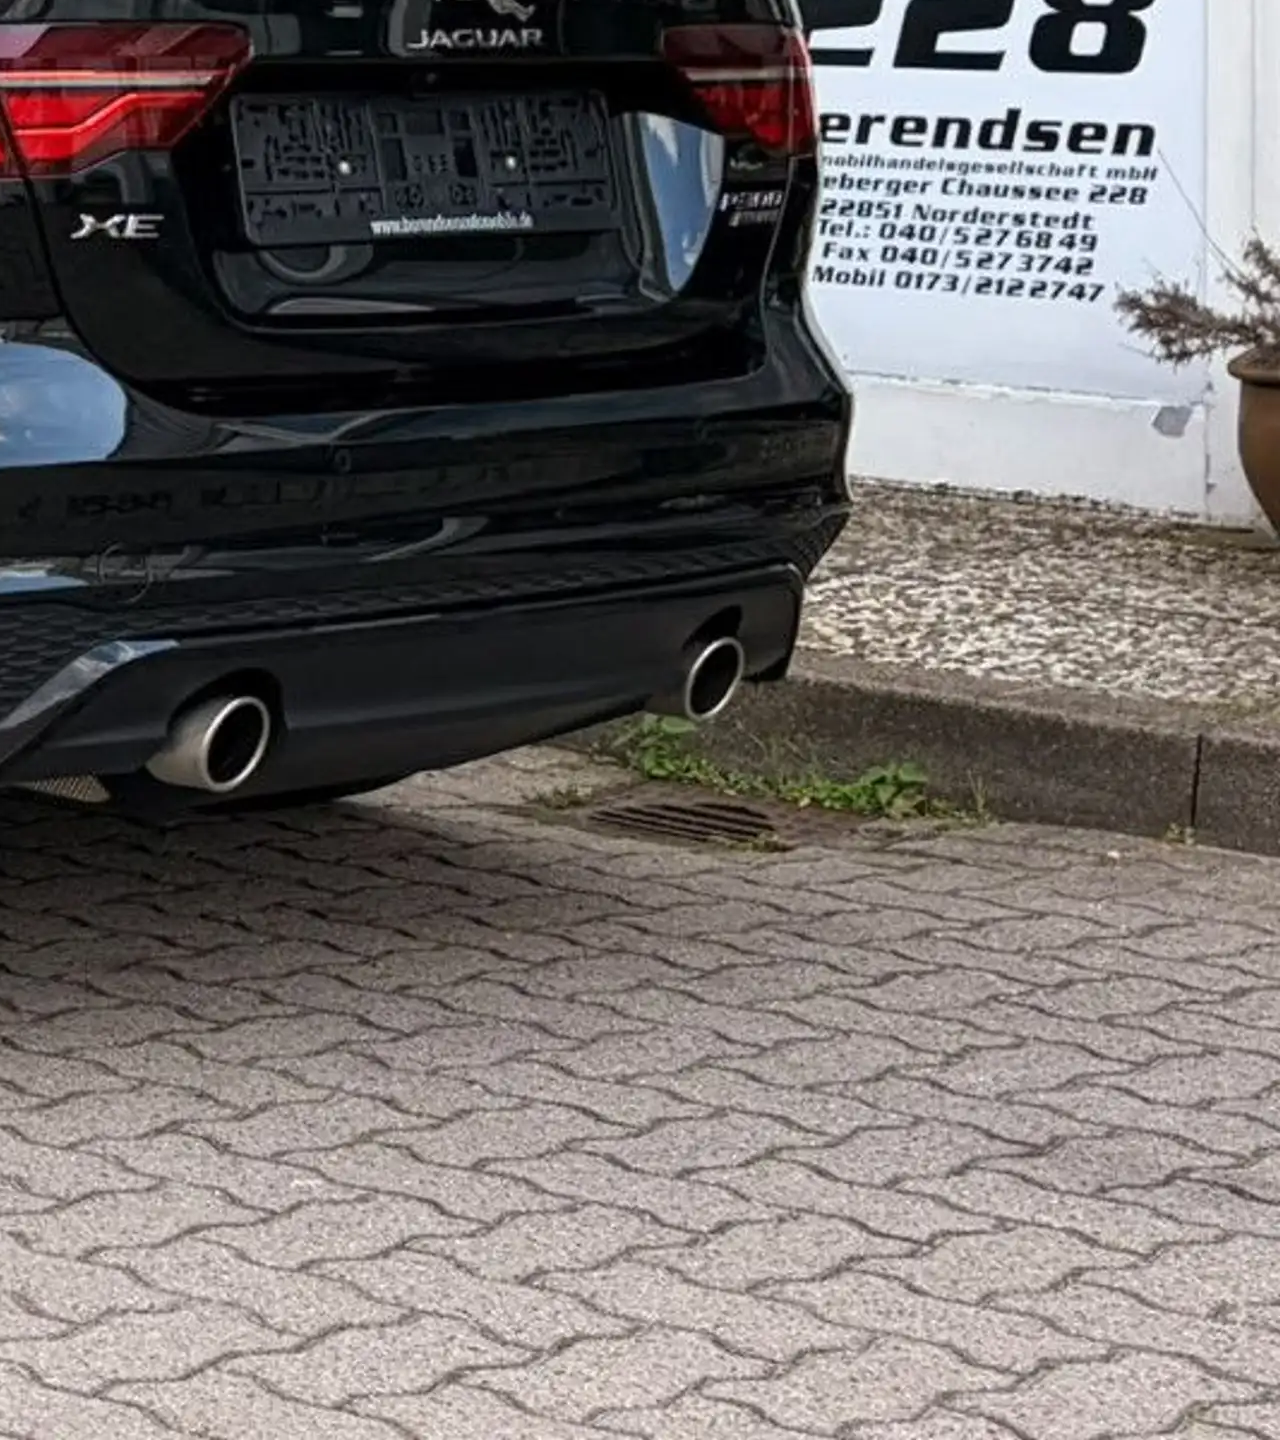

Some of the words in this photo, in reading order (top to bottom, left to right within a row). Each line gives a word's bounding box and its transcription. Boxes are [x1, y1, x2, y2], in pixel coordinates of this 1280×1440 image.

[406, 28, 543, 50] JAGUAR
[940, 177, 1081, 203] Chaussee
[1089, 184, 1149, 206] 228
[819, 197, 903, 220] 22851
[911, 203, 1096, 231] Norderstedt
[70, 213, 165, 239] XE
[817, 218, 871, 239] Tel.:
[821, 241, 872, 262] Fax
[812, 265, 886, 288] Mobil
